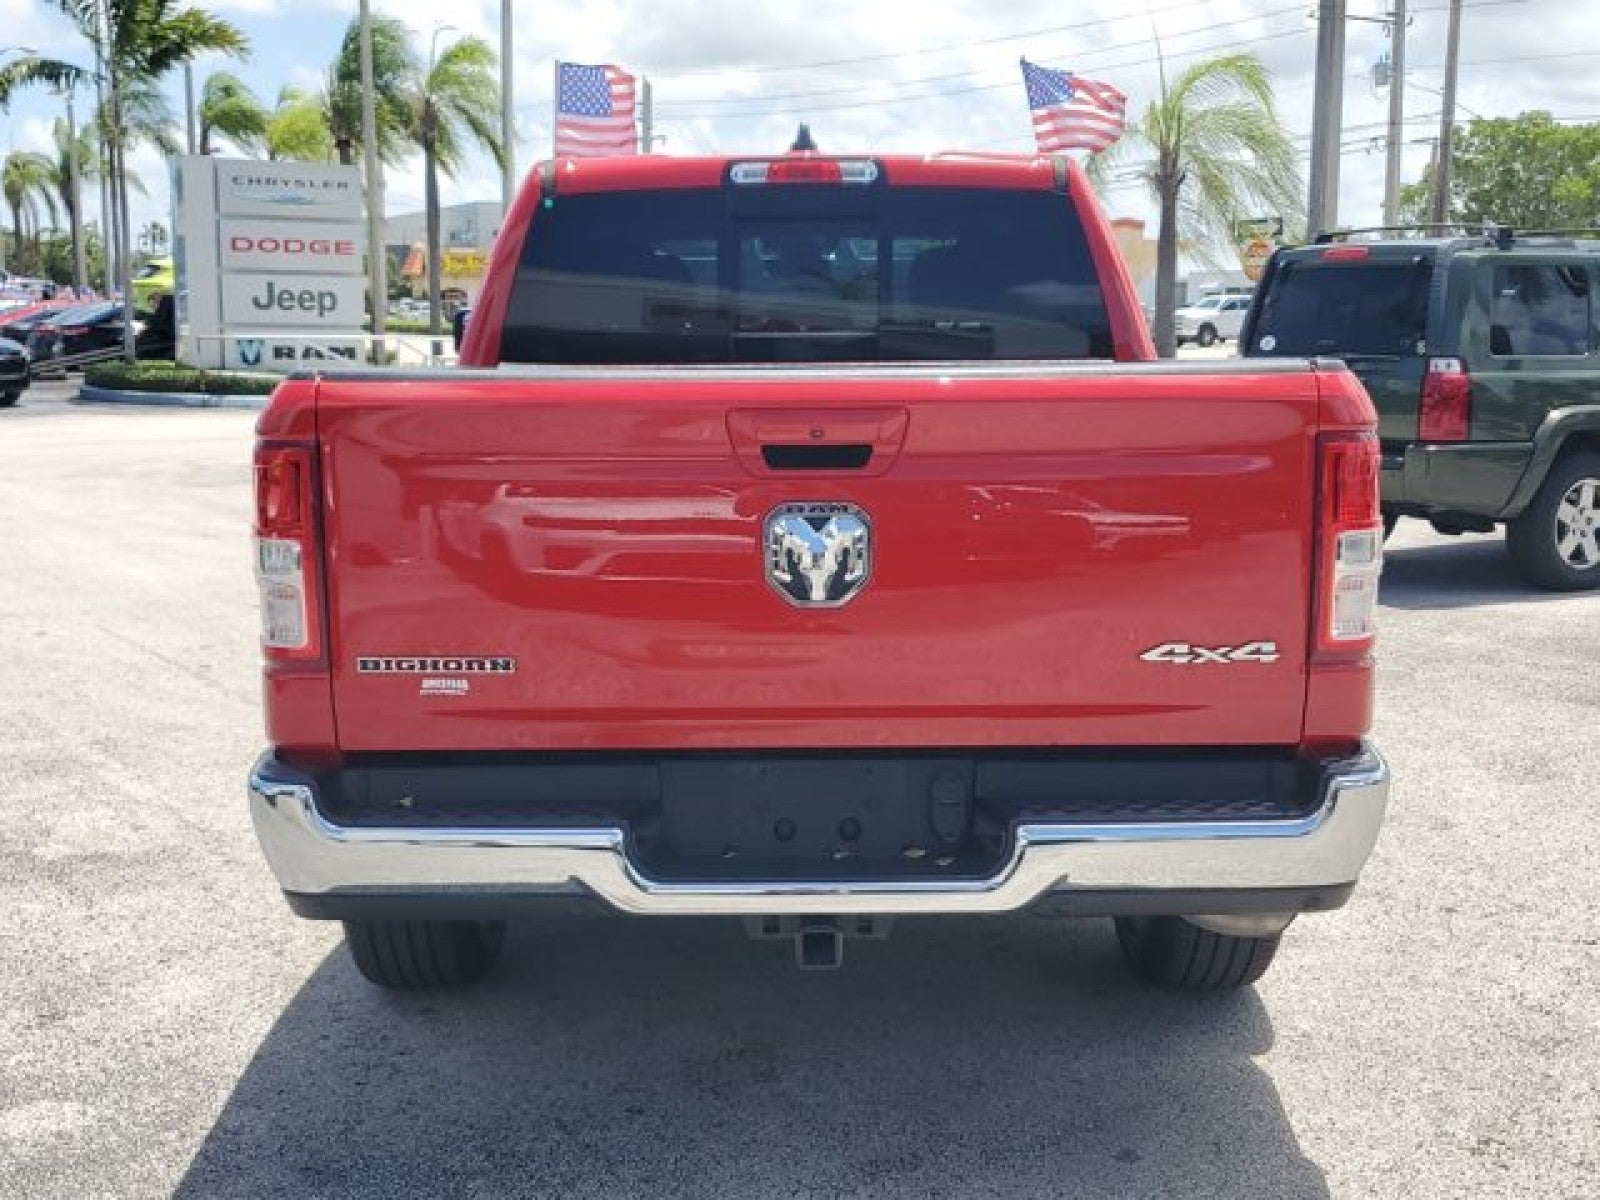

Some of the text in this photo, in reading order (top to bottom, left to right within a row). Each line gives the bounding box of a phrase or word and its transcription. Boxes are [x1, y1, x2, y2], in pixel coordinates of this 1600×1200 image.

[232, 175, 348, 190] CHRYSLER
[229, 236, 356, 256] DODGE
[252, 281, 338, 318] Jeep
[272, 345, 357, 361] RAM
[1138, 640, 1280, 664] 4x4
[356, 656, 516, 674] BIGHORN
